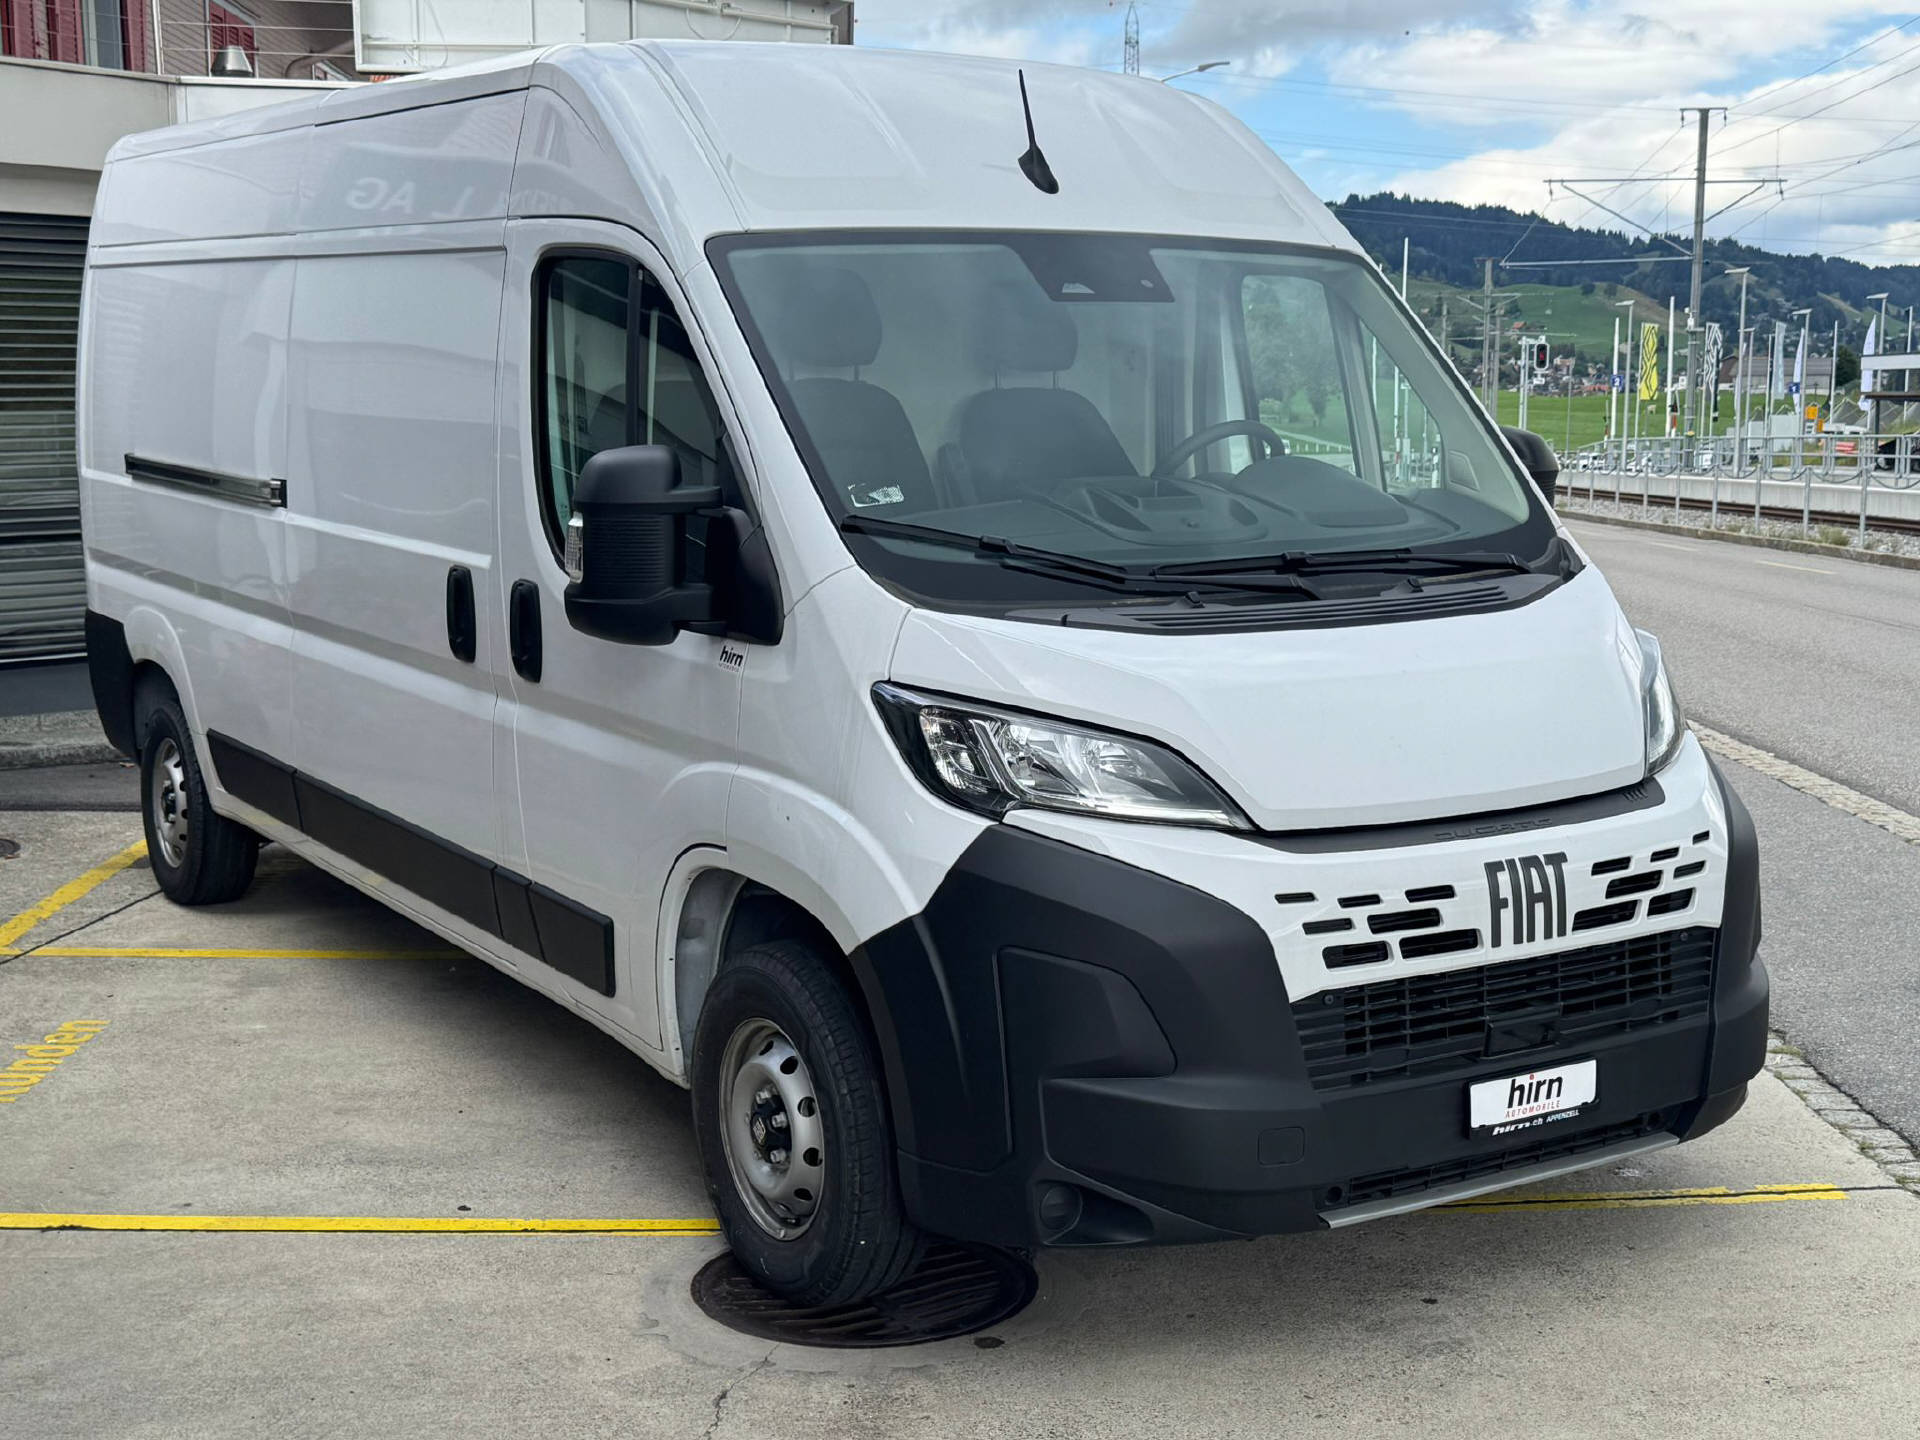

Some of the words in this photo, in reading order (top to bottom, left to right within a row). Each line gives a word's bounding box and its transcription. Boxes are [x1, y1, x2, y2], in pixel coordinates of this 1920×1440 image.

[719, 645, 744, 667] hirn
[1484, 851, 1568, 949] FIAT
[1508, 1073, 1563, 1109] hirn
[1504, 1100, 1561, 1119] AUTOMOBILE
[1546, 1109, 1580, 1123] APPENZELL
